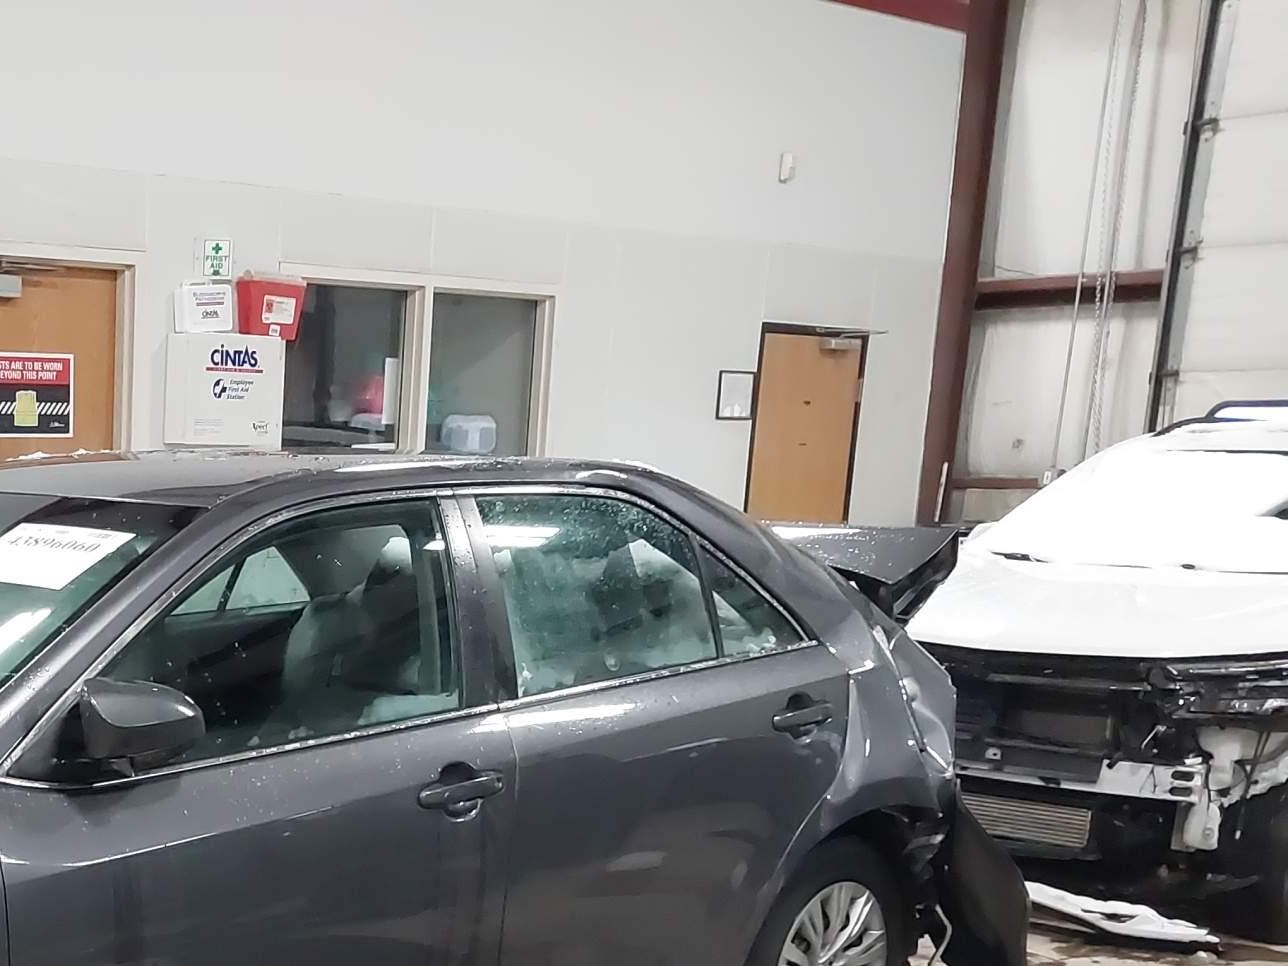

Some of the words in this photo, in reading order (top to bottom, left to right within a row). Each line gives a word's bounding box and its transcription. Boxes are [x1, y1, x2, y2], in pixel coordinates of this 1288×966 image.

[210, 262, 224, 270] AID
[210, 343, 258, 368] CINTAS
[10, 360, 24, 370] ARE
[24, 361, 33, 371] TO
[33, 361, 43, 371] BE
[42, 361, 63, 372] WORN
[22, 371, 37, 380] THIS
[37, 371, 57, 381] POINT
